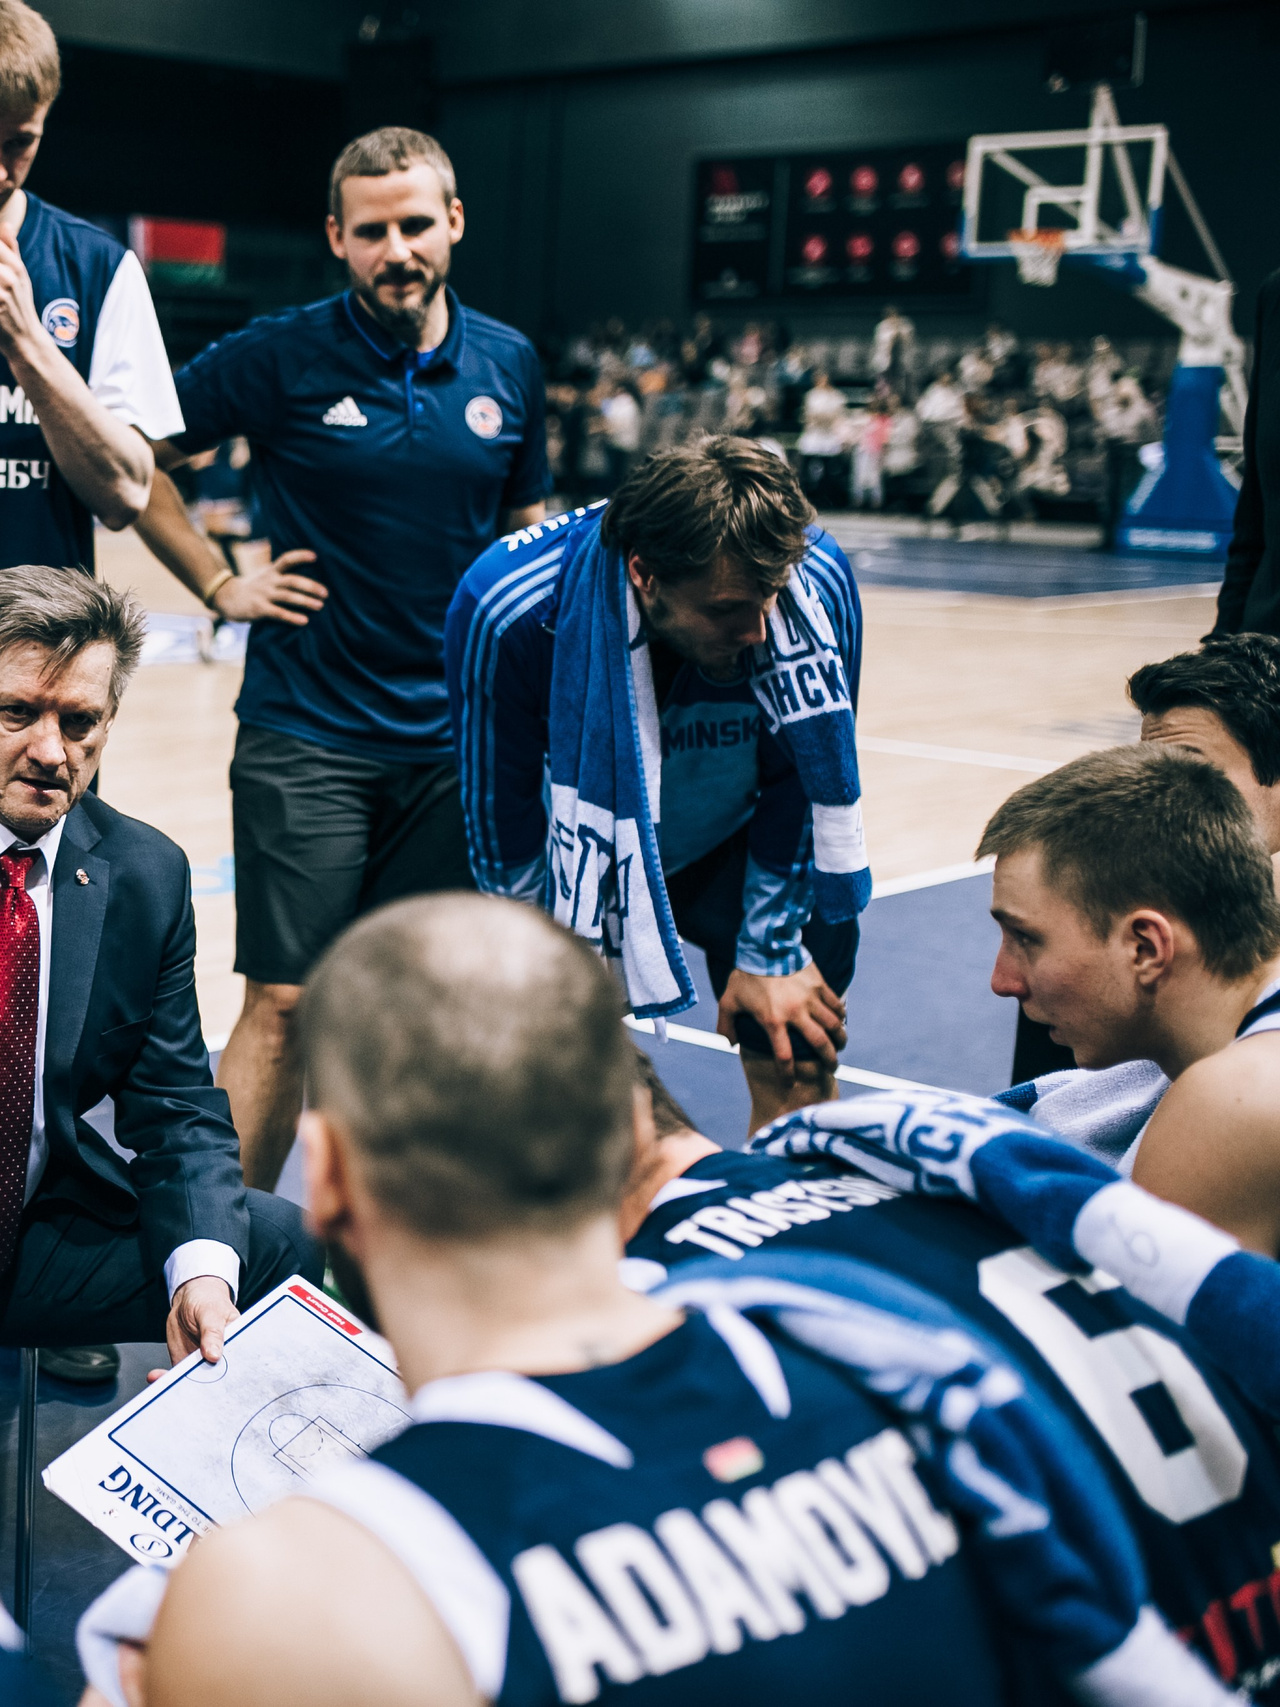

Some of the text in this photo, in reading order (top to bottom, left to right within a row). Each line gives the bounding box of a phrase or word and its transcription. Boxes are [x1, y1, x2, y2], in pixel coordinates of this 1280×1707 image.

[661, 713, 761, 760] MINSK
[306, 1296, 346, 1325] Half Court
[977, 1246, 1249, 1524] 6
[98, 1465, 203, 1546] LDING
[155, 1486, 177, 1505] GAME
[178, 1504, 190, 1518] THE
